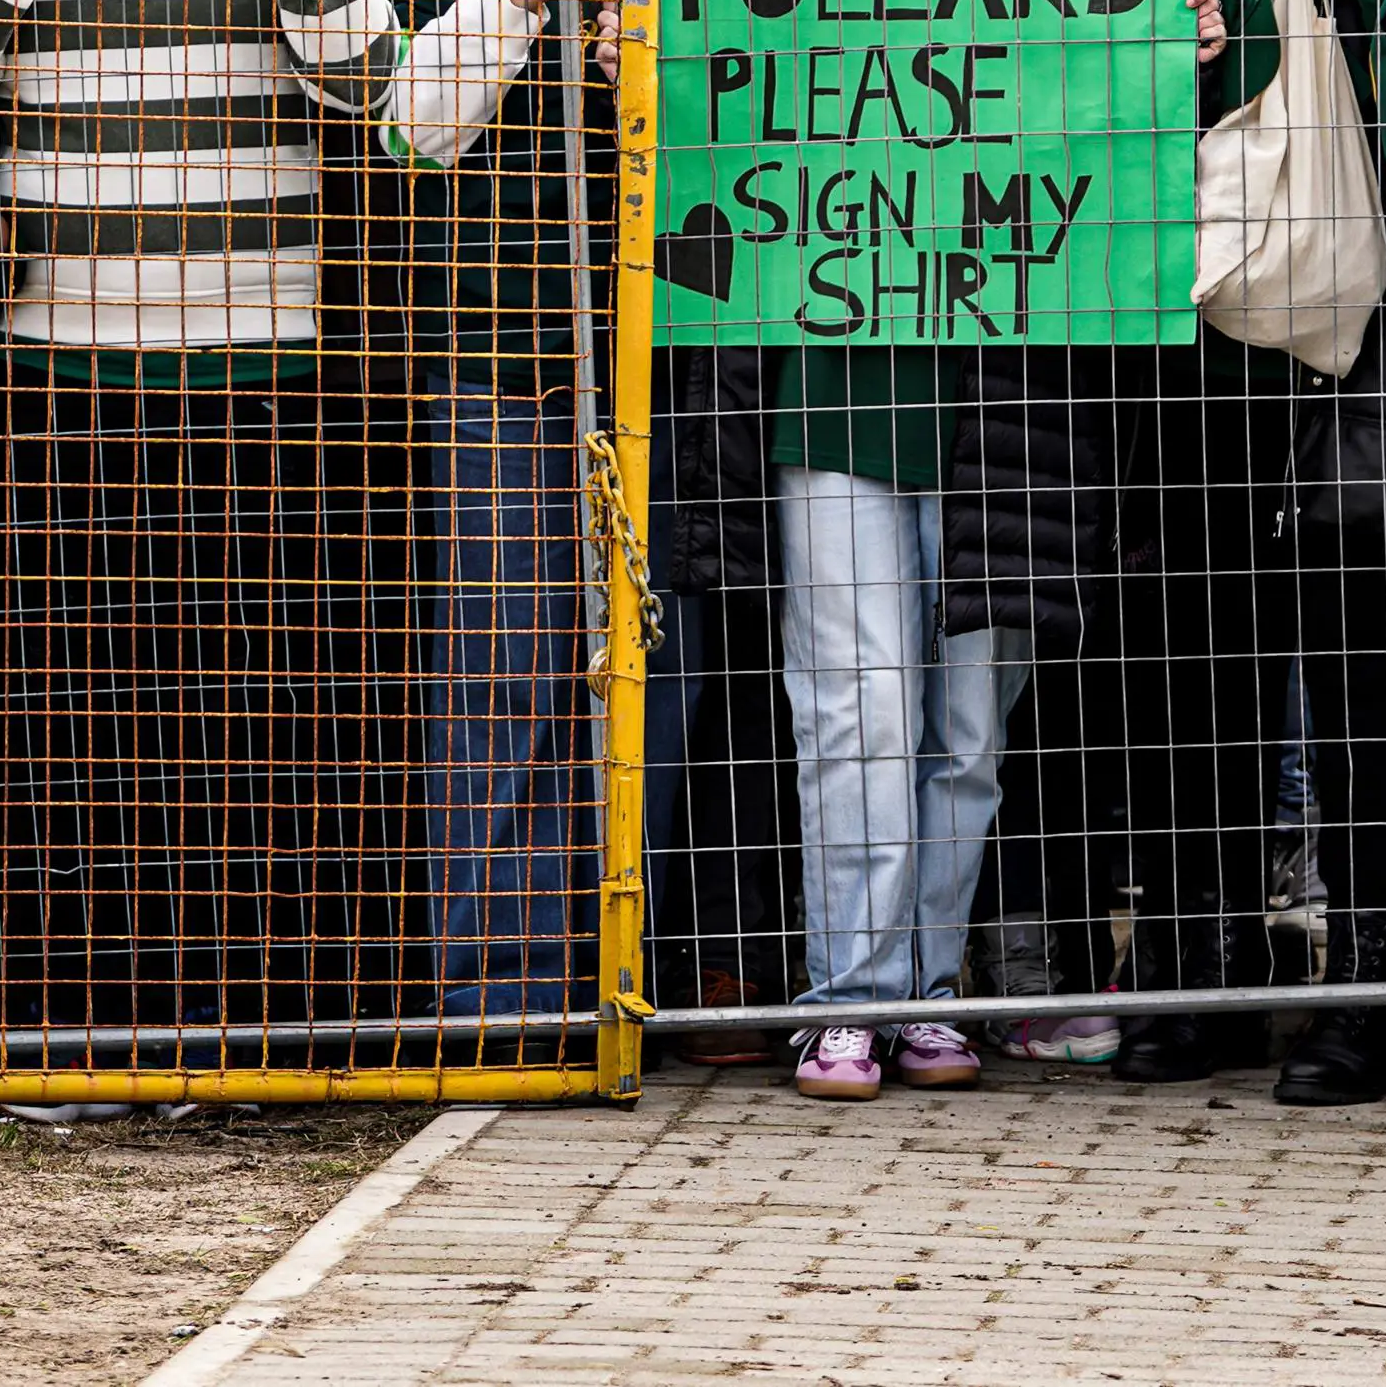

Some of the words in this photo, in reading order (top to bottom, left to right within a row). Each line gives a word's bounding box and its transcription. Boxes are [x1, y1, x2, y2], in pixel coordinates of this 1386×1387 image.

[710, 43, 1012, 149] PLEASE
[733, 161, 916, 248] SIGN
[962, 171, 1092, 256] MY
[795, 247, 1056, 339] SHIRT
